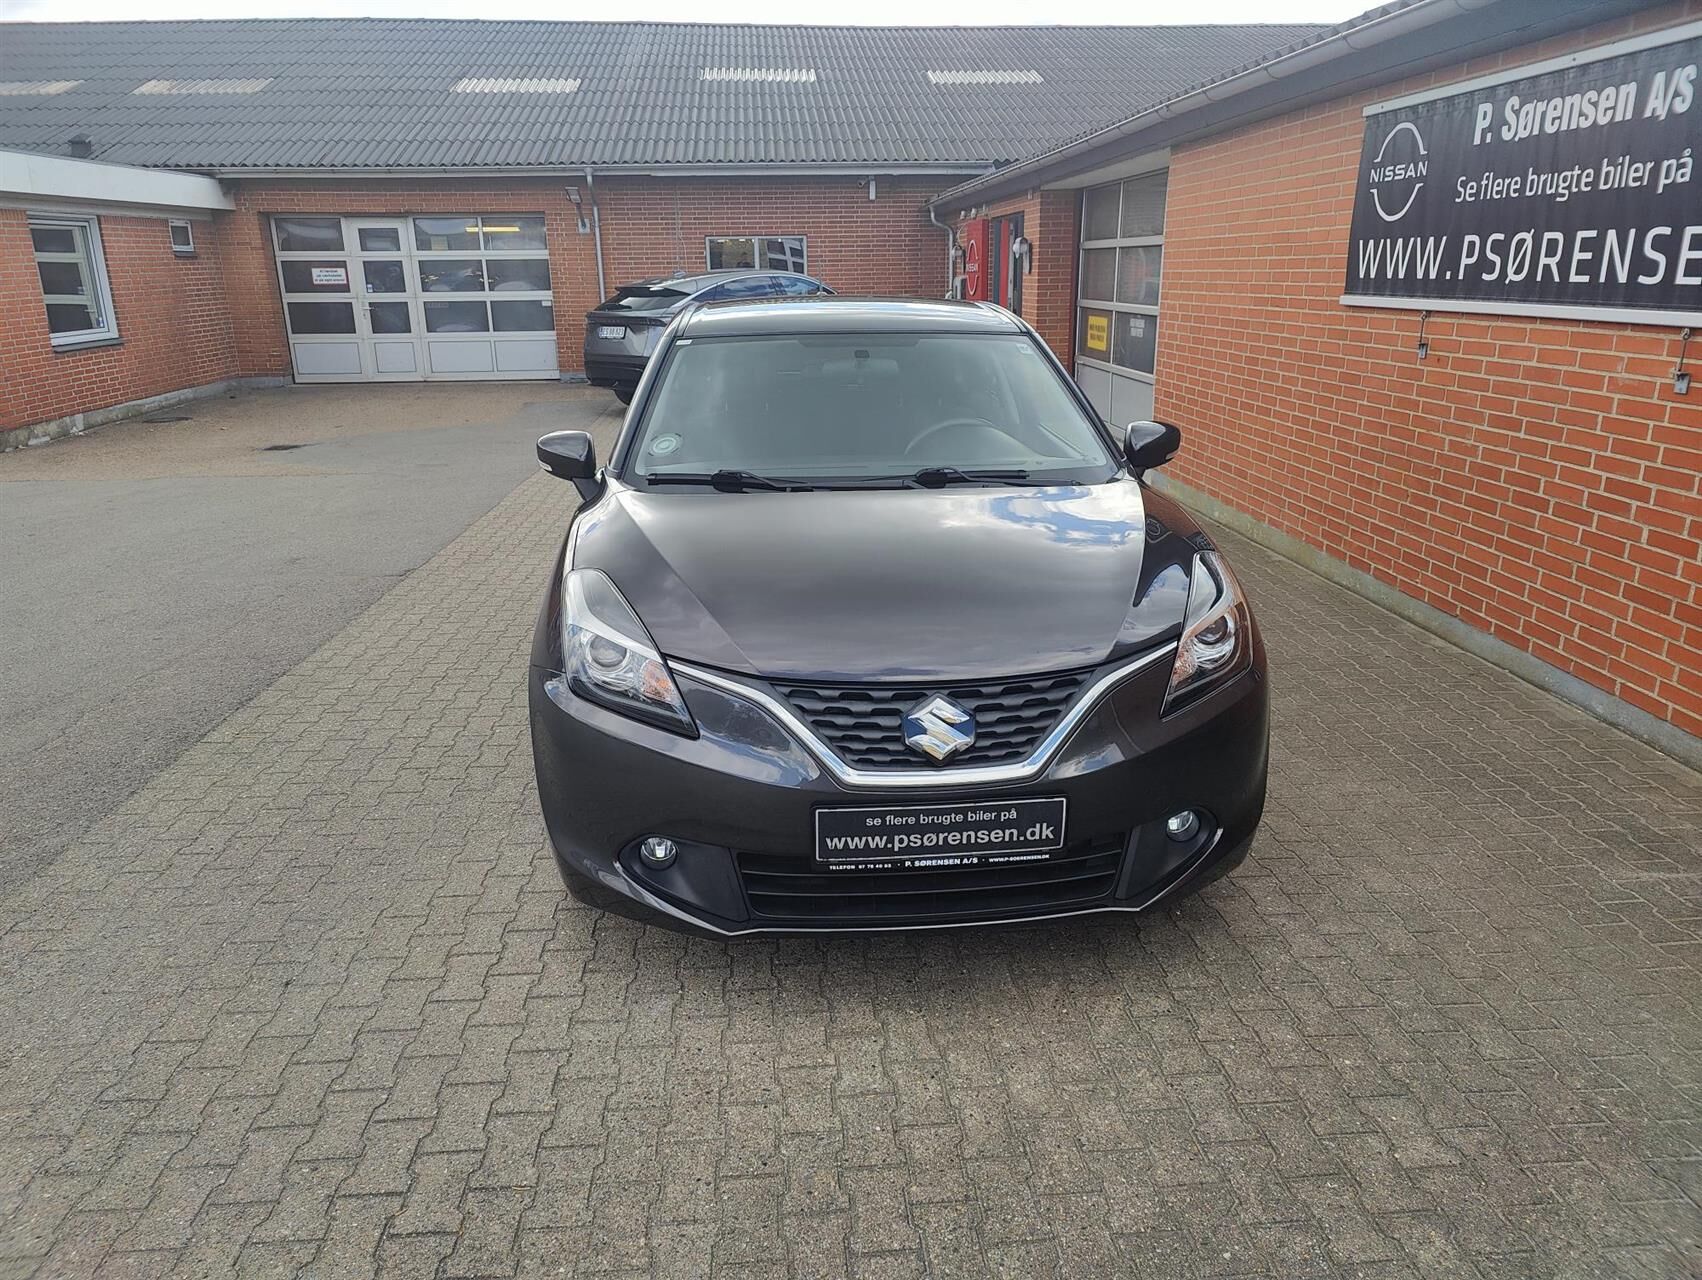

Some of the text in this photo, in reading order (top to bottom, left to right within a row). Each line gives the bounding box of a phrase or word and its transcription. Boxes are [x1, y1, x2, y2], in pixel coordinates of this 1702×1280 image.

[1472, 64, 1698, 146] P. Sørensen A/S
[1369, 160, 1429, 184] NISSAN
[1455, 148, 1694, 203] Se flere brugte biler på
[865, 807, 1018, 826] se flere brugte biler på
[825, 822, 1055, 852] www.psørensen.dk
